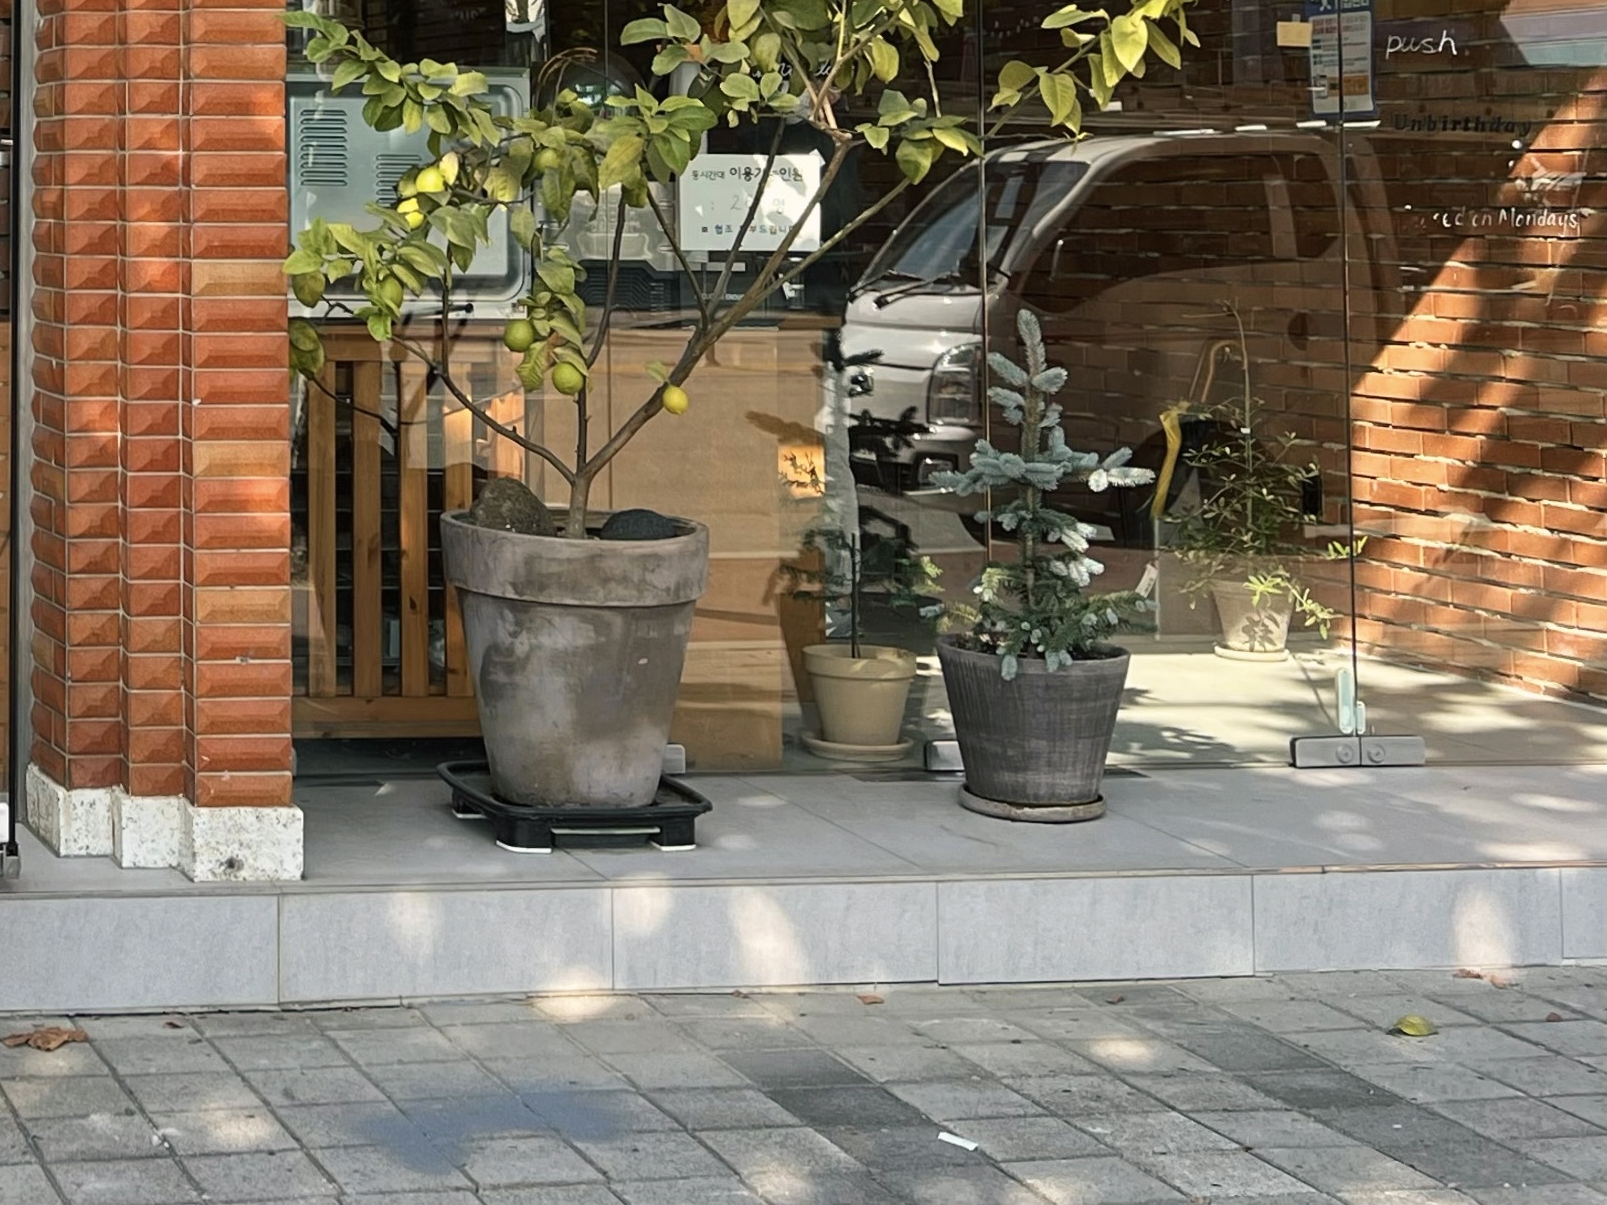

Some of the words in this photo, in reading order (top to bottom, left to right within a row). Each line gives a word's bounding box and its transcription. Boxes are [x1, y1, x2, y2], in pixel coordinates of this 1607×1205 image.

[1384, 29, 1457, 60] push
[1394, 113, 1532, 136] Unbirthday
[729, 166, 804, 182] 이용인원
[1498, 207, 1578, 233] Mondays
